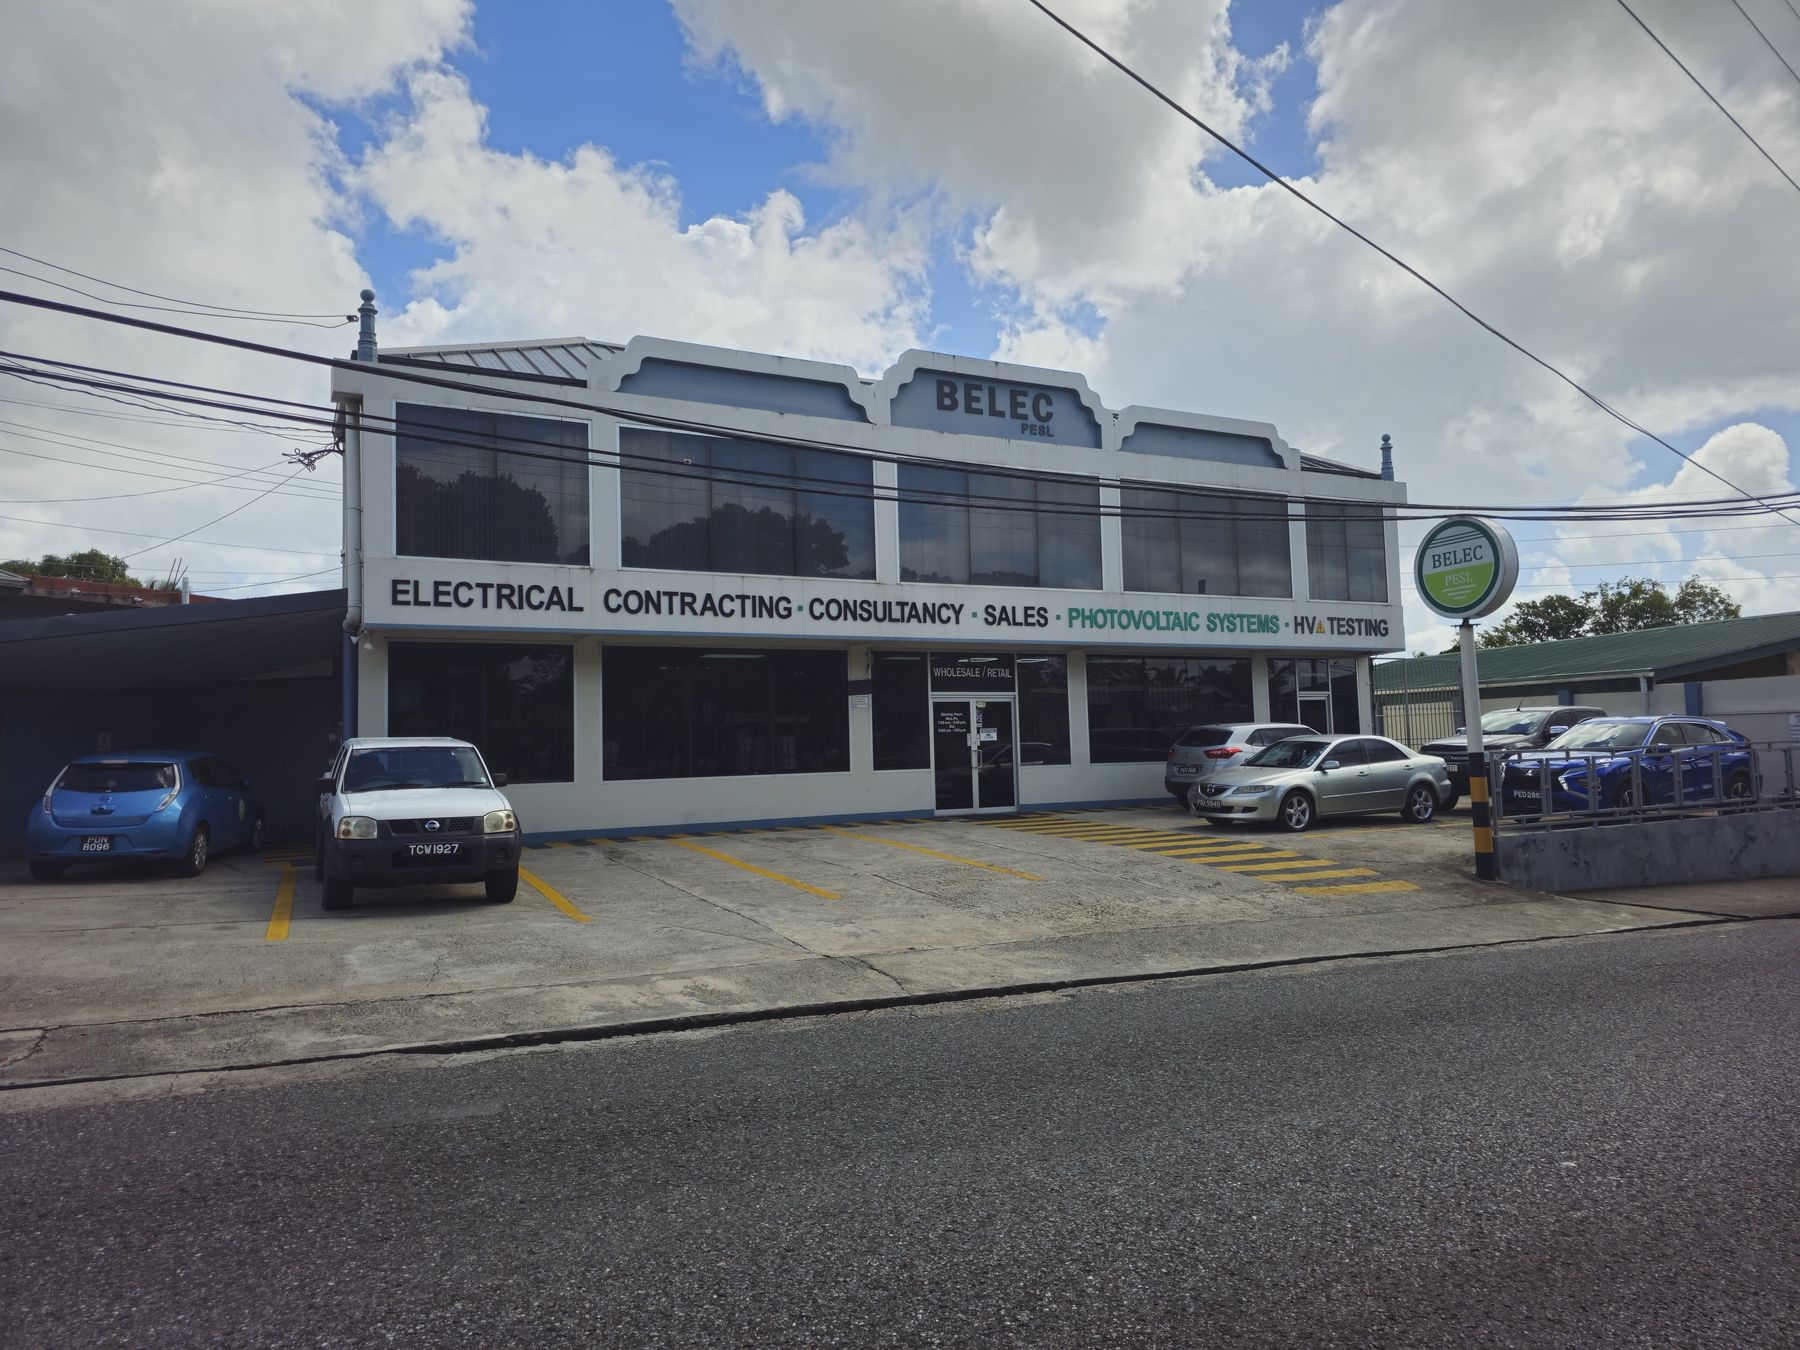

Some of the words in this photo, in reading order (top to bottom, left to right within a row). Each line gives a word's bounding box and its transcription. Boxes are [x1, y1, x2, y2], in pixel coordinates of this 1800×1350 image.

[936, 379, 1054, 423] BELEC
[1021, 422, 1055, 437] PESL
[1431, 545, 1484, 569] BELEC
[1444, 571, 1473, 586] PESL
[391, 579, 584, 612] ELECTRICAL
[603, 588, 792, 619] CONTRACTING
[808, 597, 965, 624] CONSULTANCY
[983, 604, 1049, 627] SALES
[1067, 607, 1200, 632] PHOTOVOLTAIC
[1206, 612, 1280, 634] SYSTEMS
[1294, 615, 1317, 634] HV
[1327, 616, 1389, 637] TESTING
[933, 667, 980, 677] WHOLESALE
[987, 668, 1012, 678] RETAIL
[82, 843, 110, 851] 8096
[409, 843, 459, 855] TCW1927
